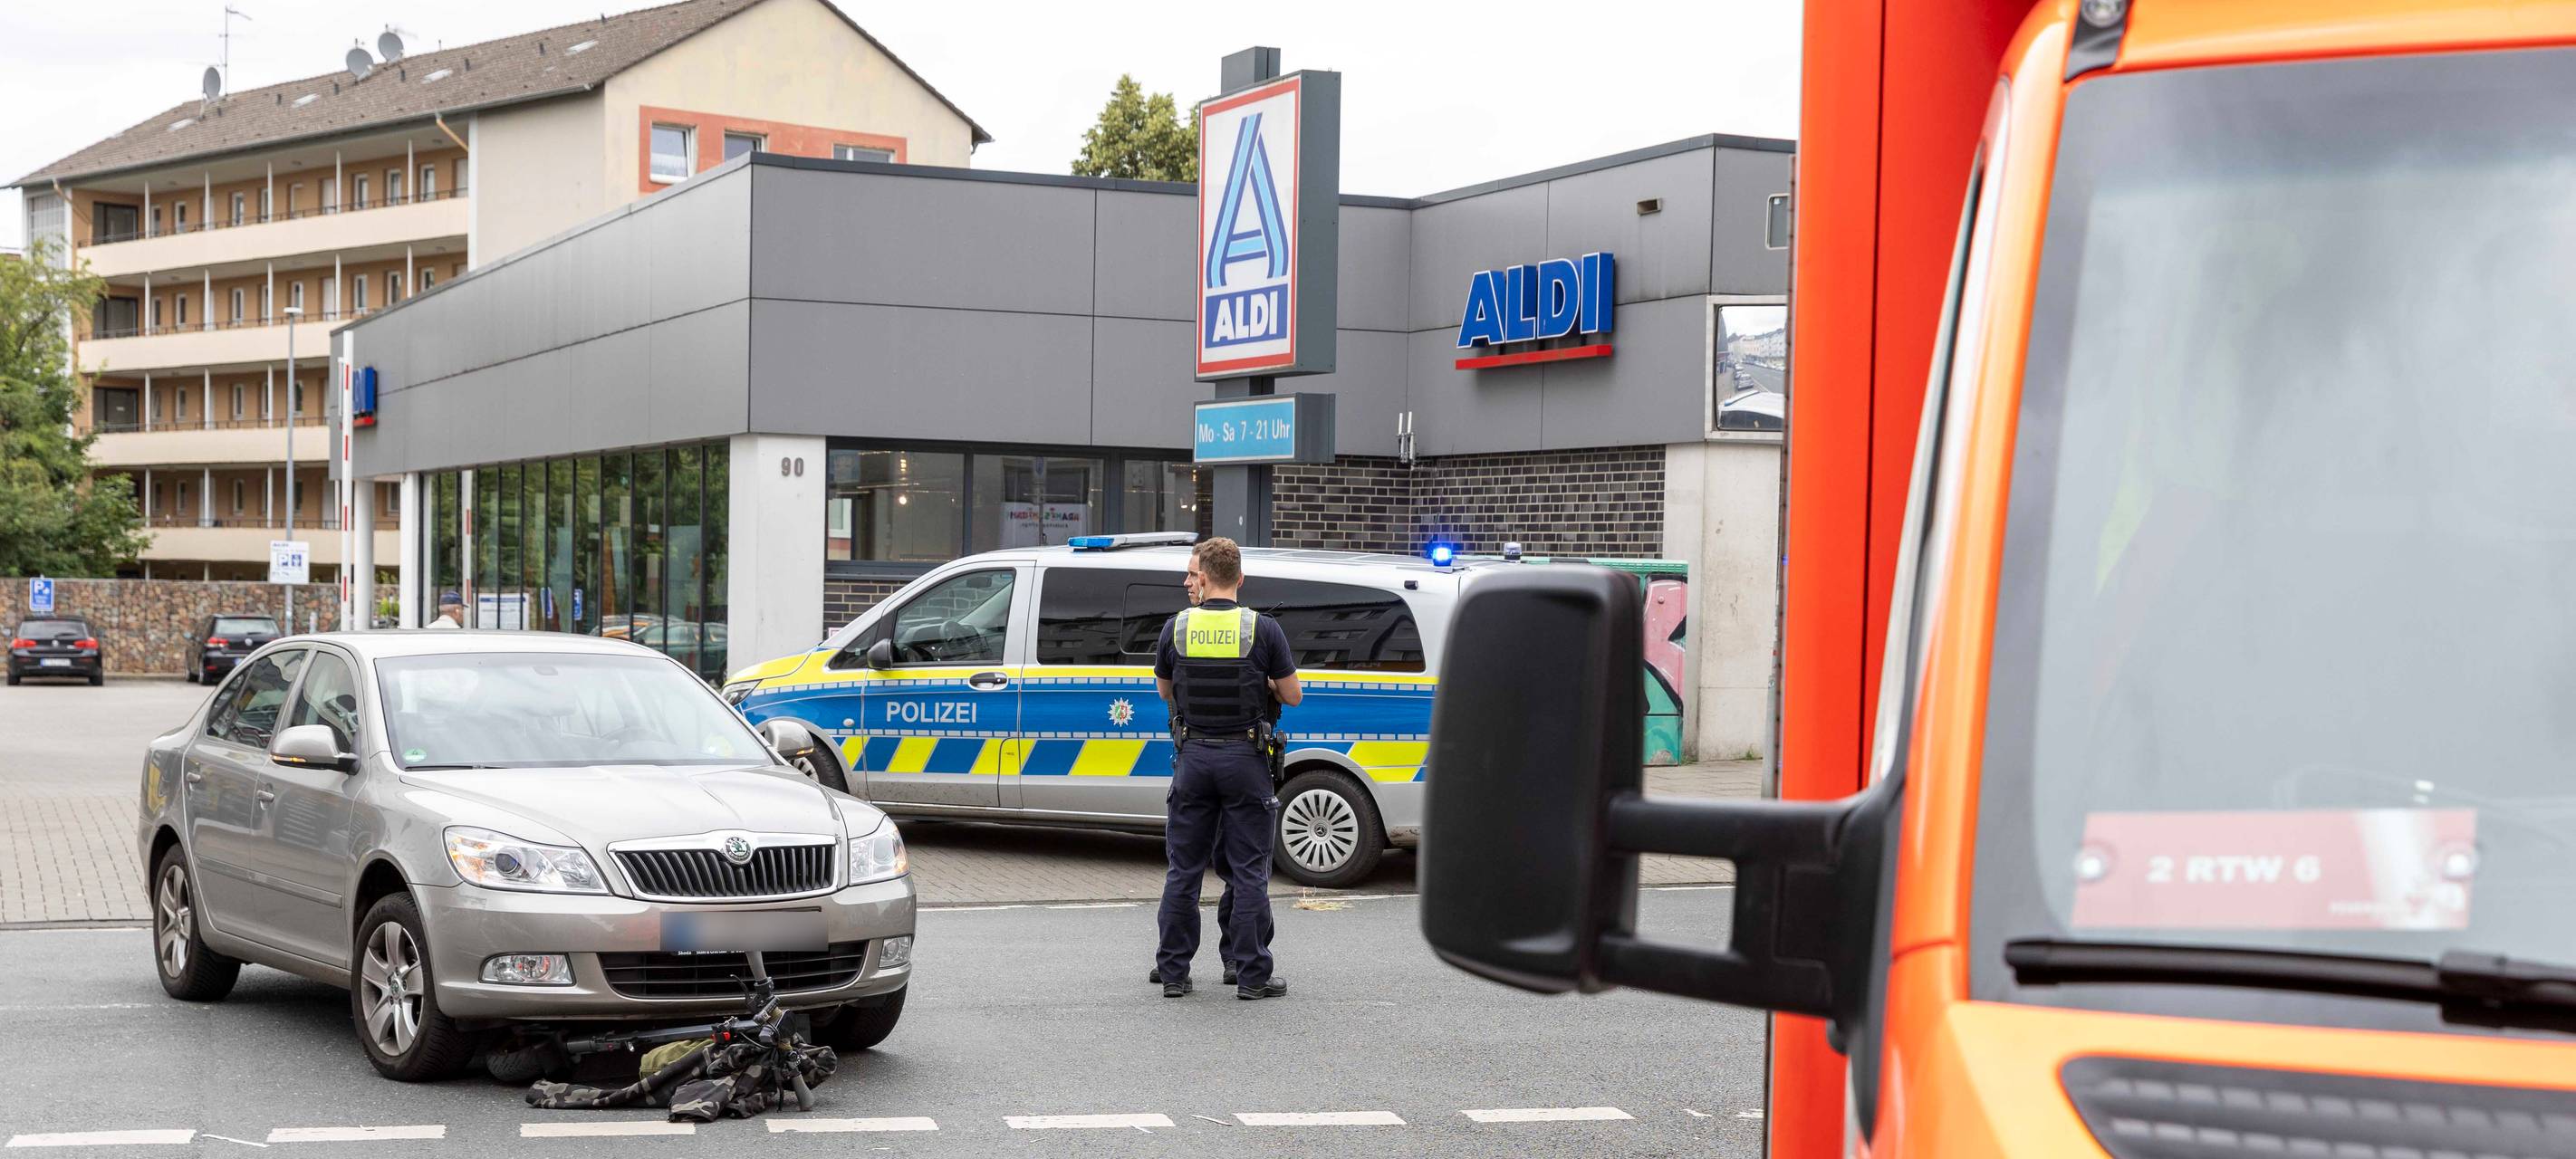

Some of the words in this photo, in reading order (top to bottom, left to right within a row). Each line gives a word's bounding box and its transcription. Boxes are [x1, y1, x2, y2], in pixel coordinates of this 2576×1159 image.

[1456, 252, 1613, 348] ALDI
[1212, 290, 1278, 342] ALDI
[1198, 424, 1215, 443] Mo
[1223, 422, 1235, 442] Sa
[1240, 420, 1247, 441] 7
[1255, 419, 1267, 439] 21
[1272, 418, 1291, 439] Uhr
[781, 456, 804, 477] 90
[1190, 629, 1235, 645] POLIZEI
[886, 701, 977, 723] POLIZEI
[2145, 855, 2173, 884] 2
[2186, 855, 2283, 884] RTW
[2293, 855, 2321, 884] 6
